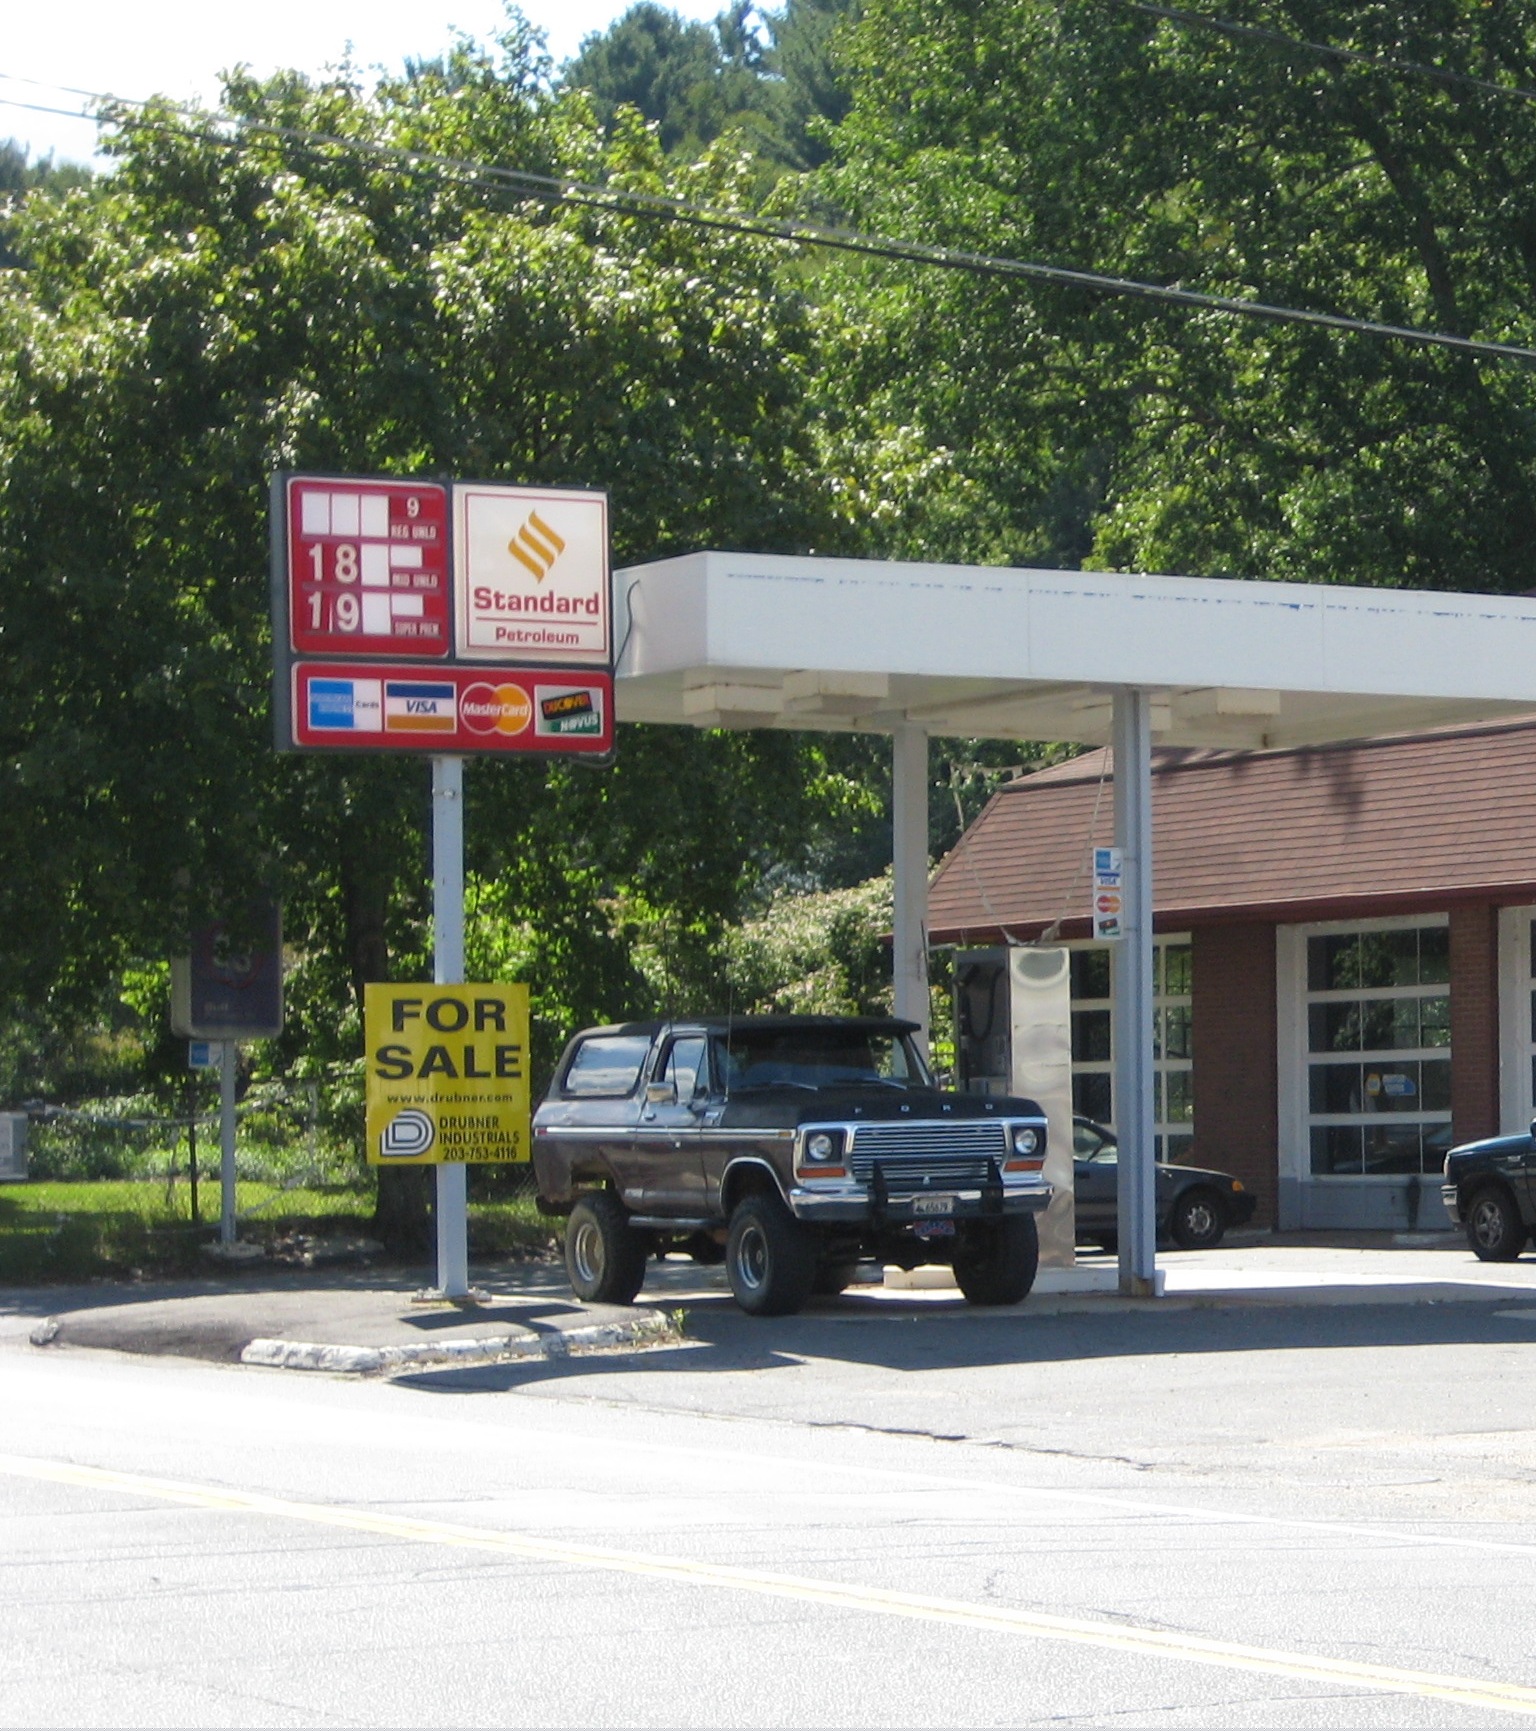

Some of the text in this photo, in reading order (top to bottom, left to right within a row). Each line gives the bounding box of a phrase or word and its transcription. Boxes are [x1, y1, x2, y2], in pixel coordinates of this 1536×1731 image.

[406, 496, 420, 519] 9
[474, 586, 600, 615] Standard
[495, 626, 580, 645] Petroleum
[406, 701, 437, 714] VISA
[463, 701, 529, 718] MasterCard
[392, 998, 506, 1033] FOR
[375, 1045, 522, 1079] SALE
[387, 1092, 513, 1104] www.drubner.com
[439, 1116, 499, 1129] DRUBNER
[439, 1132, 520, 1145] INDUSTRIALS
